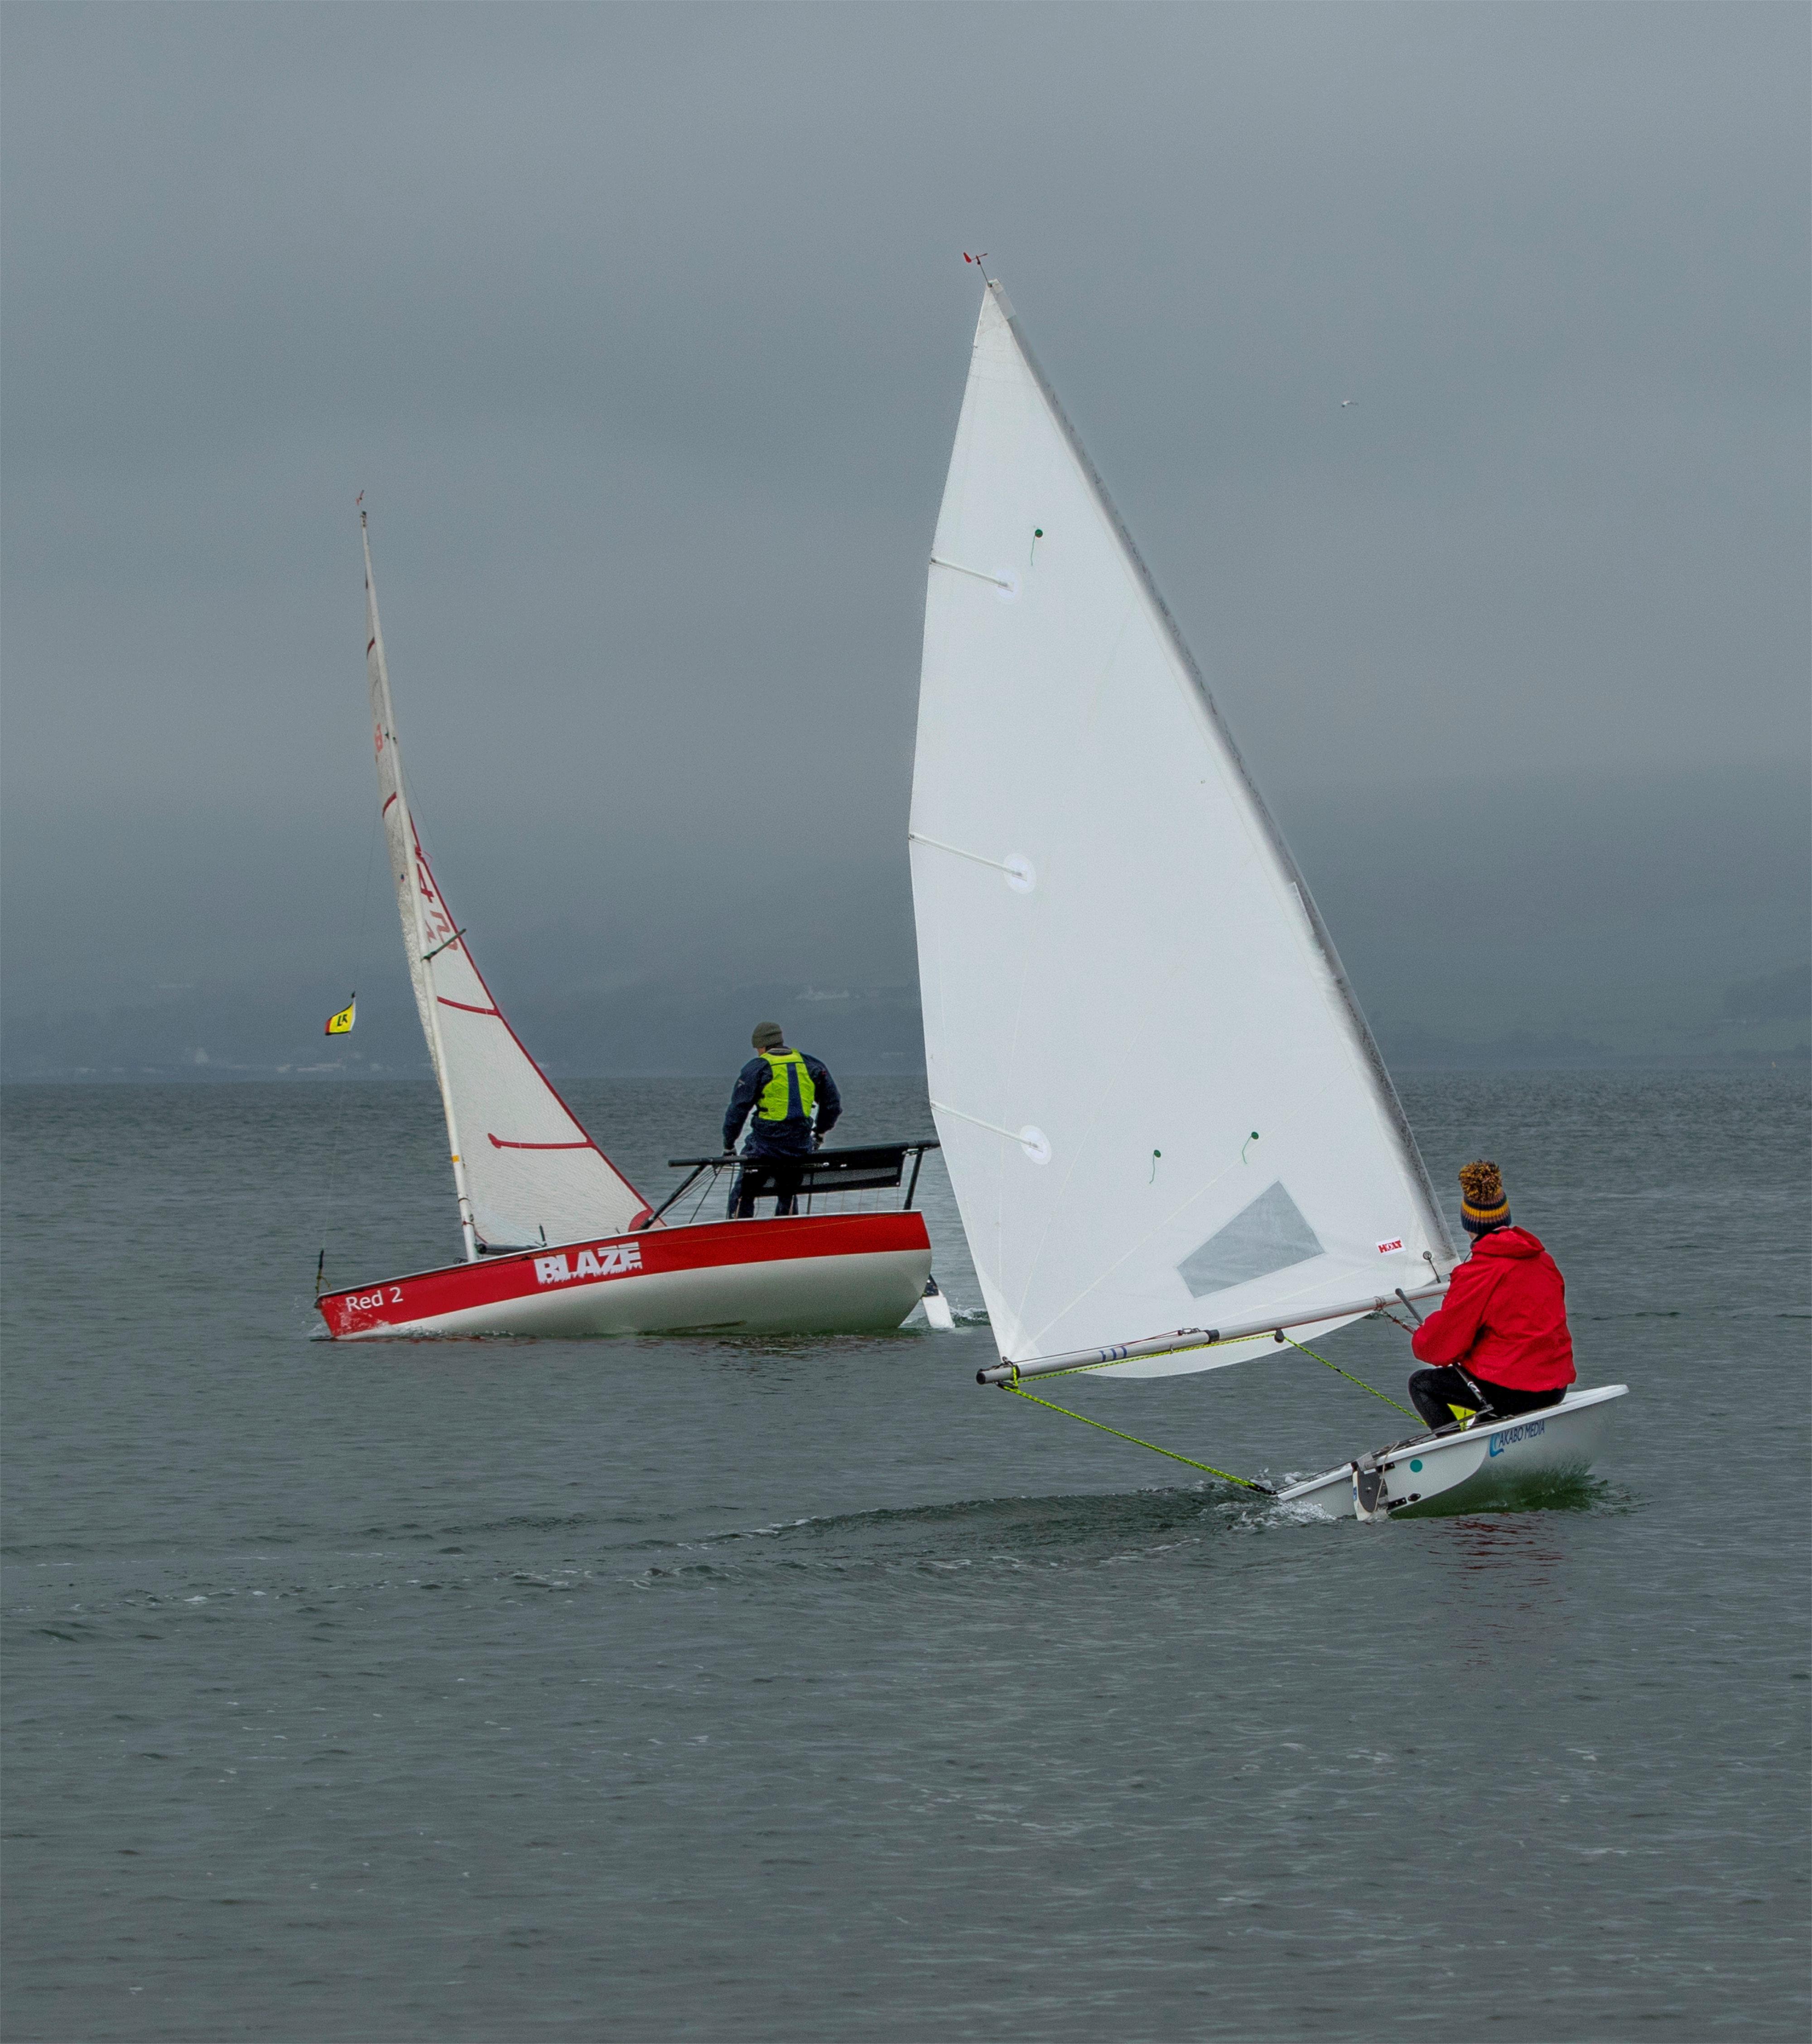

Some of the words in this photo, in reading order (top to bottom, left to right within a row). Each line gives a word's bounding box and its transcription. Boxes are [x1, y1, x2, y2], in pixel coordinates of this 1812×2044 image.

[534, 1242, 643, 1284] BLAZE
[346, 1290, 383, 1312] Red
[390, 1287, 404, 1303] 2
[1524, 1421, 1545, 1439] MEDIA
